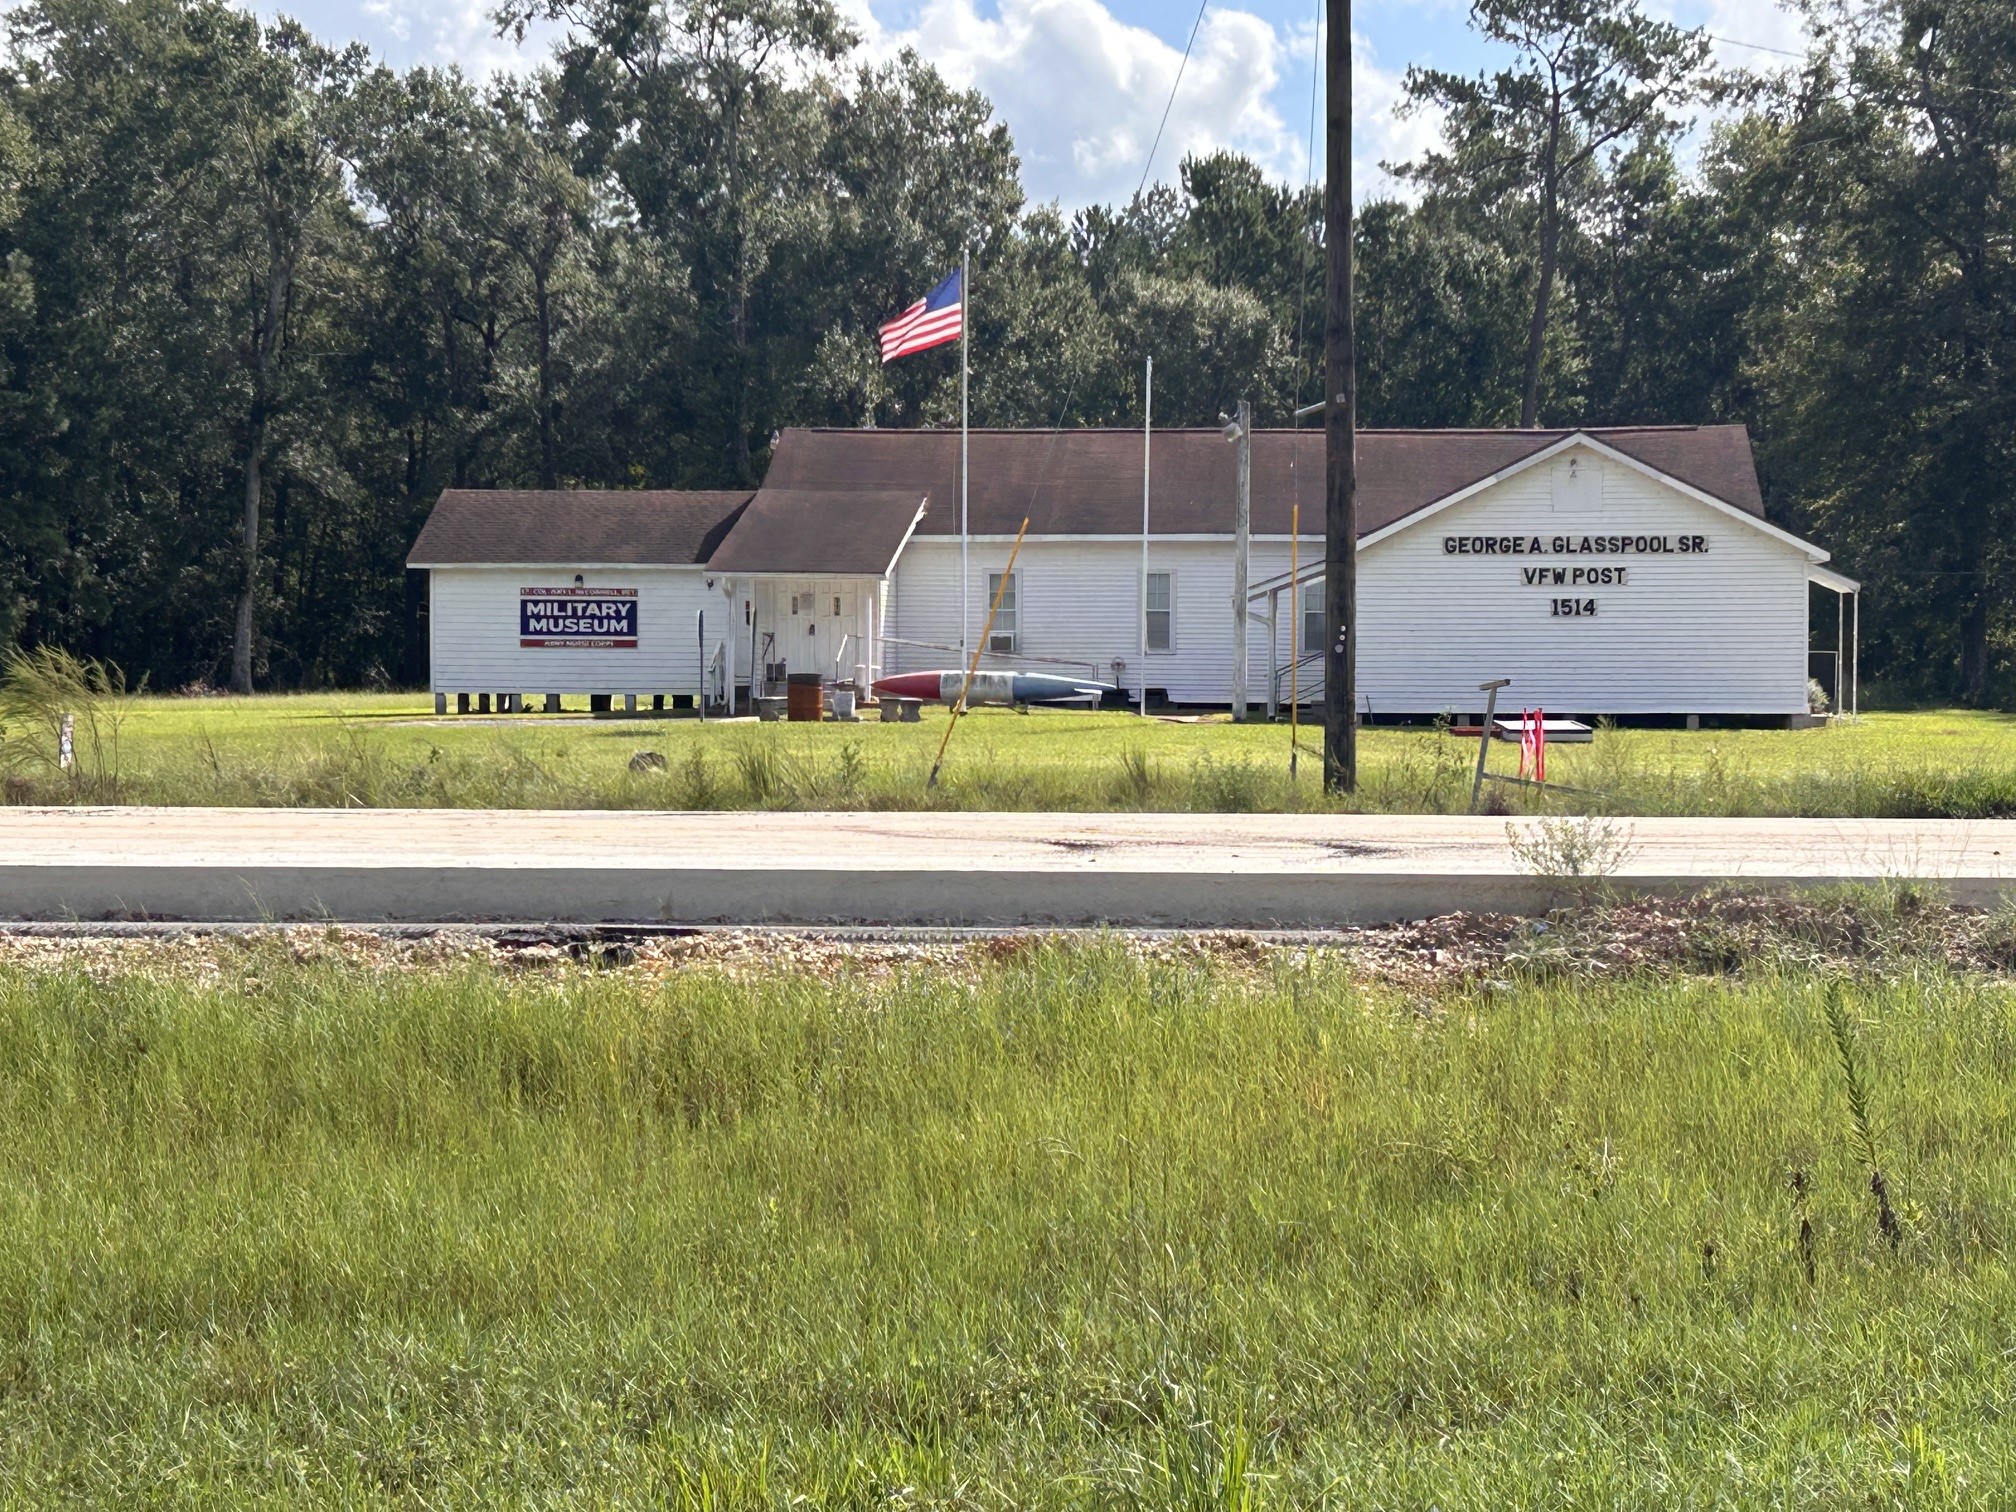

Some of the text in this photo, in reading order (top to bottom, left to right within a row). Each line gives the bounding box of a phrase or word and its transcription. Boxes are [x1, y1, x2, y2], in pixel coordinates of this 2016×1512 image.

[1444, 535, 1709, 554] GEORGE A. GLASSPOOL SR.
[1524, 567, 1626, 585] VFW POST
[526, 602, 632, 617] MILITARY
[1552, 598, 1596, 616] 1514
[529, 618, 628, 633] MUSEUM
